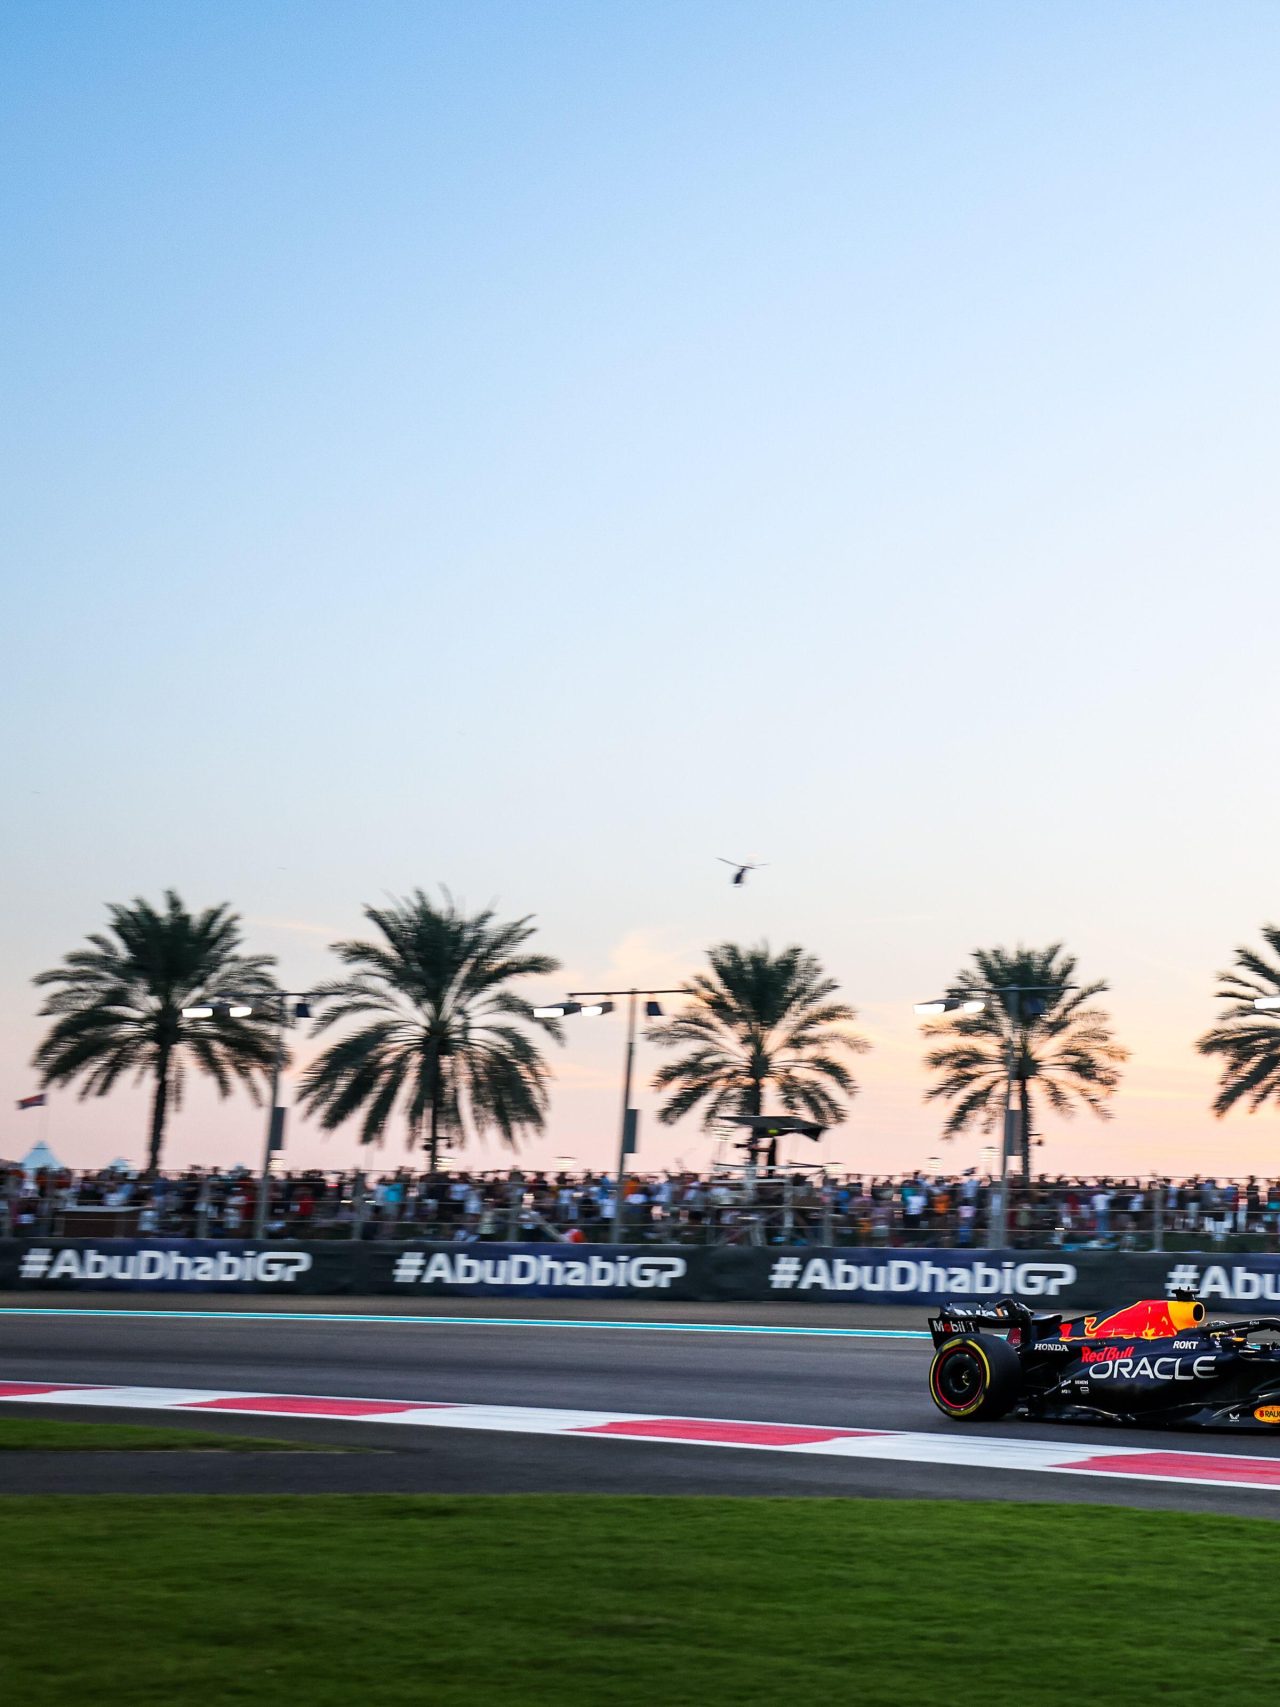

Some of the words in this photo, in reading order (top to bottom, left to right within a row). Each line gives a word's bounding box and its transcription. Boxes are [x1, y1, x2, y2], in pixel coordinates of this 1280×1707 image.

[19, 1249, 312, 1282] #AbuDhabiGP
[393, 1252, 687, 1288] #AbuDhabiGP
[768, 1257, 1077, 1296] #AbuDhabiGP
[933, 1320, 966, 1333] Mobil
[1034, 1343, 1069, 1352] HONDA
[1172, 1340, 1199, 1350] ROKT
[1088, 1355, 1219, 1381] ORACLE
